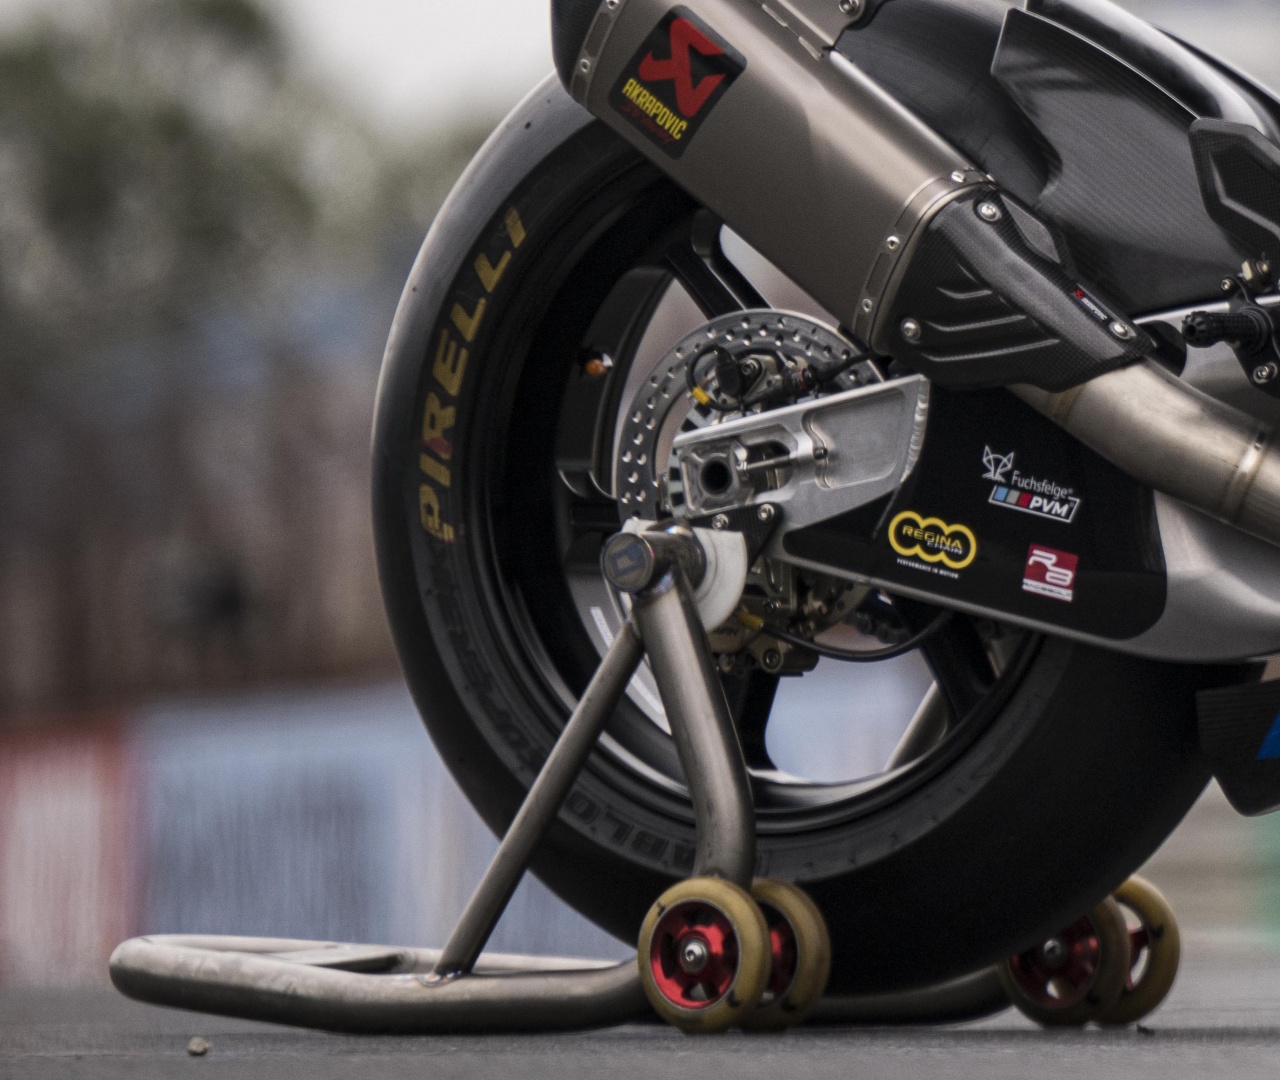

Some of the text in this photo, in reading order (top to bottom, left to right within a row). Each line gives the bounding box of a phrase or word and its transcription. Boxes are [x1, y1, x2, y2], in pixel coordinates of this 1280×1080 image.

[418, 206, 528, 543] PIRELLI
[1011, 470, 1068, 500] Fuchsfelge
[1029, 496, 1069, 517] PVM
[902, 525, 962, 550] REGINA
